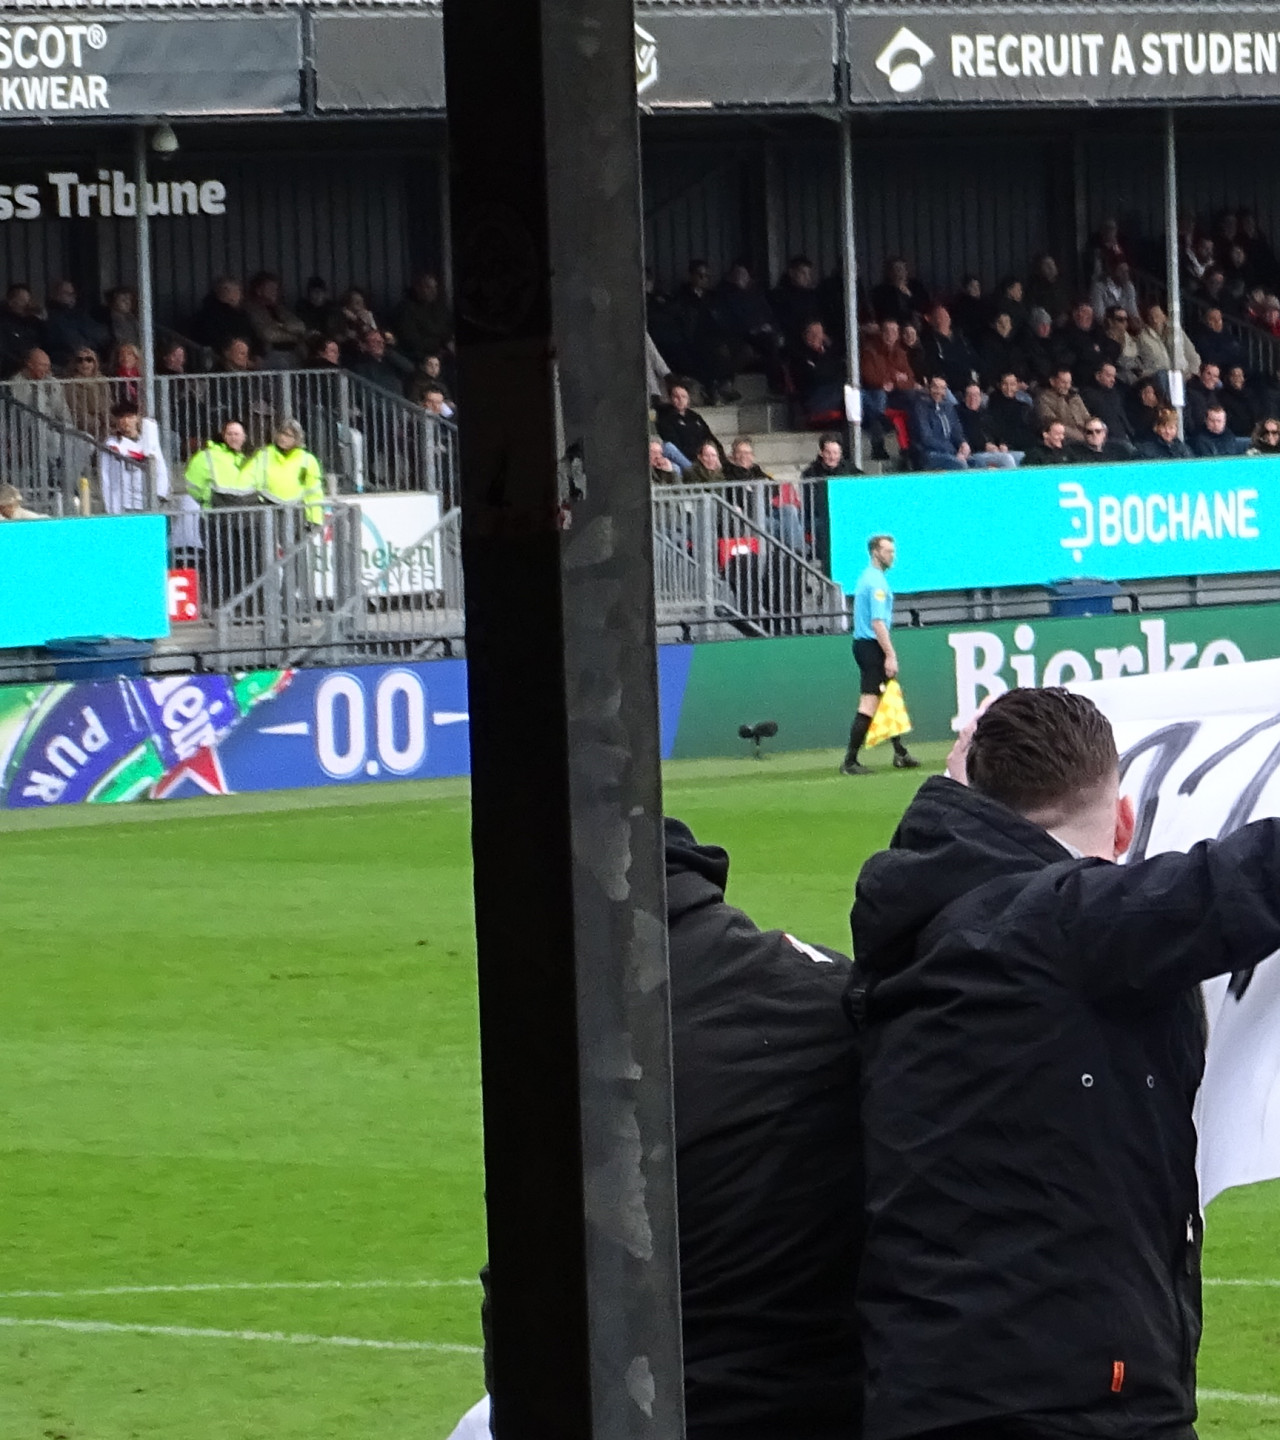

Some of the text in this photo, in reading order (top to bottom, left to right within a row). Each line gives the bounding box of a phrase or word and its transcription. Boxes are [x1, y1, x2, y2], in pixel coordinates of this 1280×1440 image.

[951, 33, 1102, 78] RECRUIT
[1111, 33, 1136, 75] A
[48, 168, 227, 218] Tribune
[1099, 489, 1259, 547] BOCHANE
[316, 671, 426, 777] 0.0
[23, 705, 111, 803] PUR
